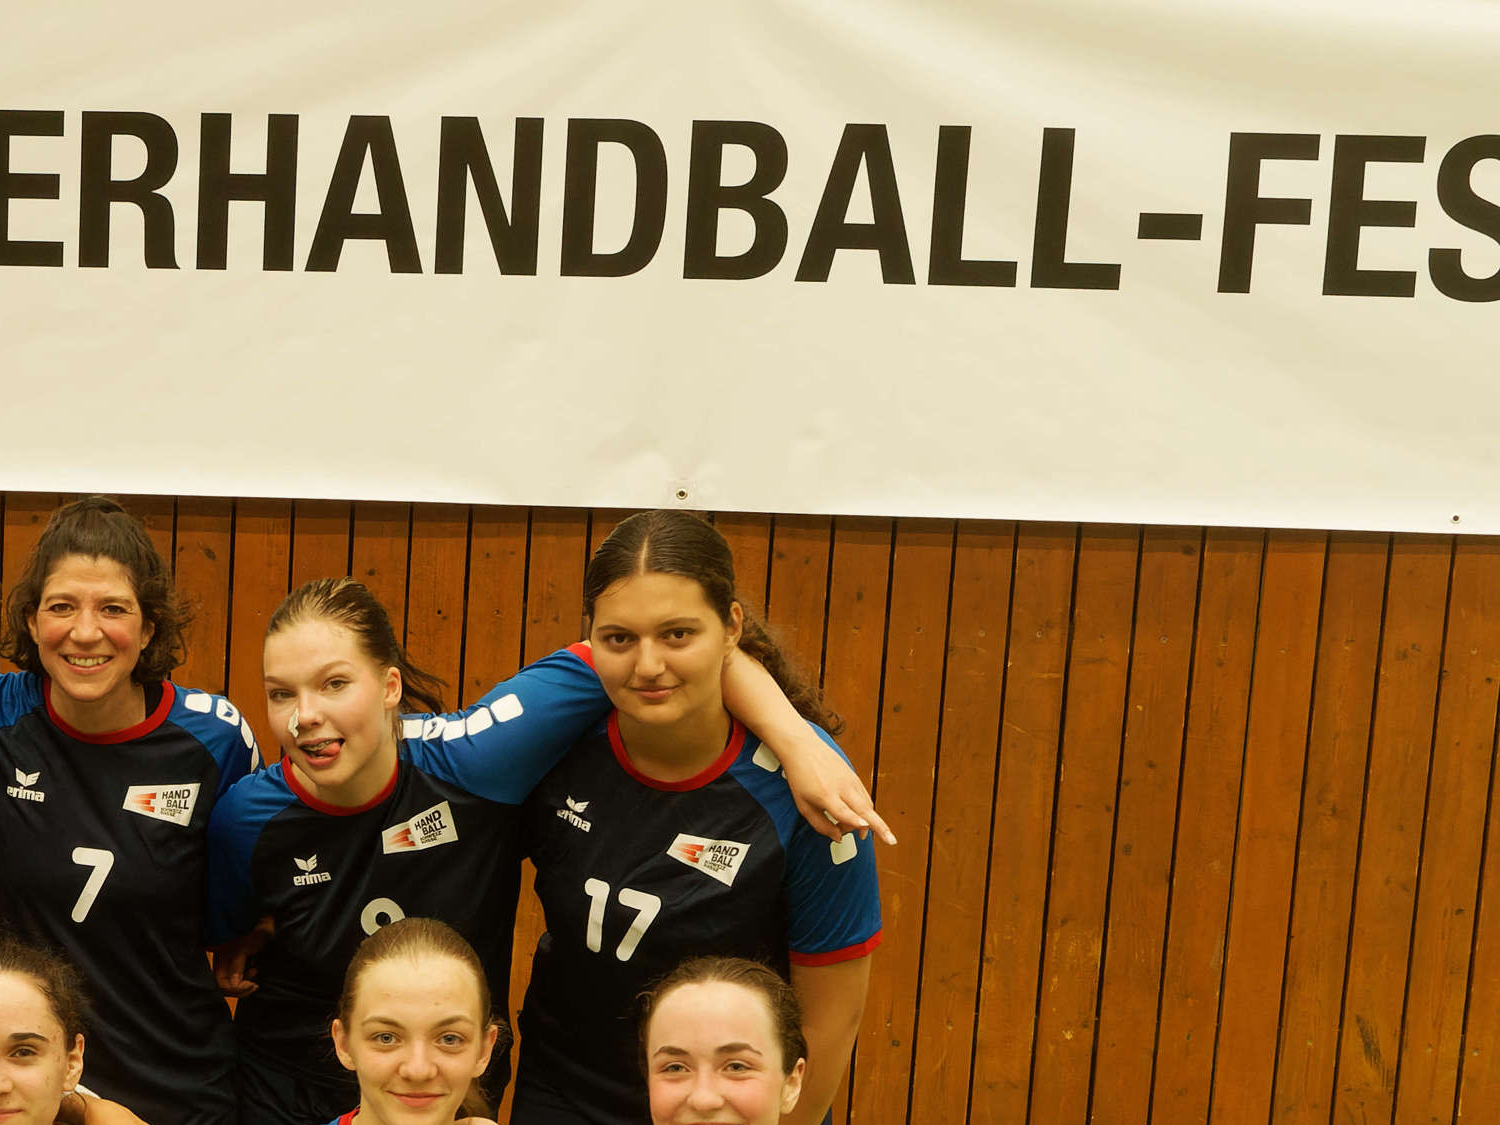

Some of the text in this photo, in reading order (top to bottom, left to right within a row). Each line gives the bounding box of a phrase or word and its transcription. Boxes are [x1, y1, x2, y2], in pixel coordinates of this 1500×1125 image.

[6, 785, 45, 802] erima
[162, 789, 191, 800] HAND
[166, 799, 189, 810] BALL
[414, 810, 442, 831] HAND
[422, 820, 447, 836] BALL
[556, 808, 592, 832] erima
[708, 845, 740, 857] HAND
[711, 853, 733, 868] BALL
[71, 846, 114, 923] 7
[293, 871, 332, 886] erima
[584, 877, 662, 962] 17
